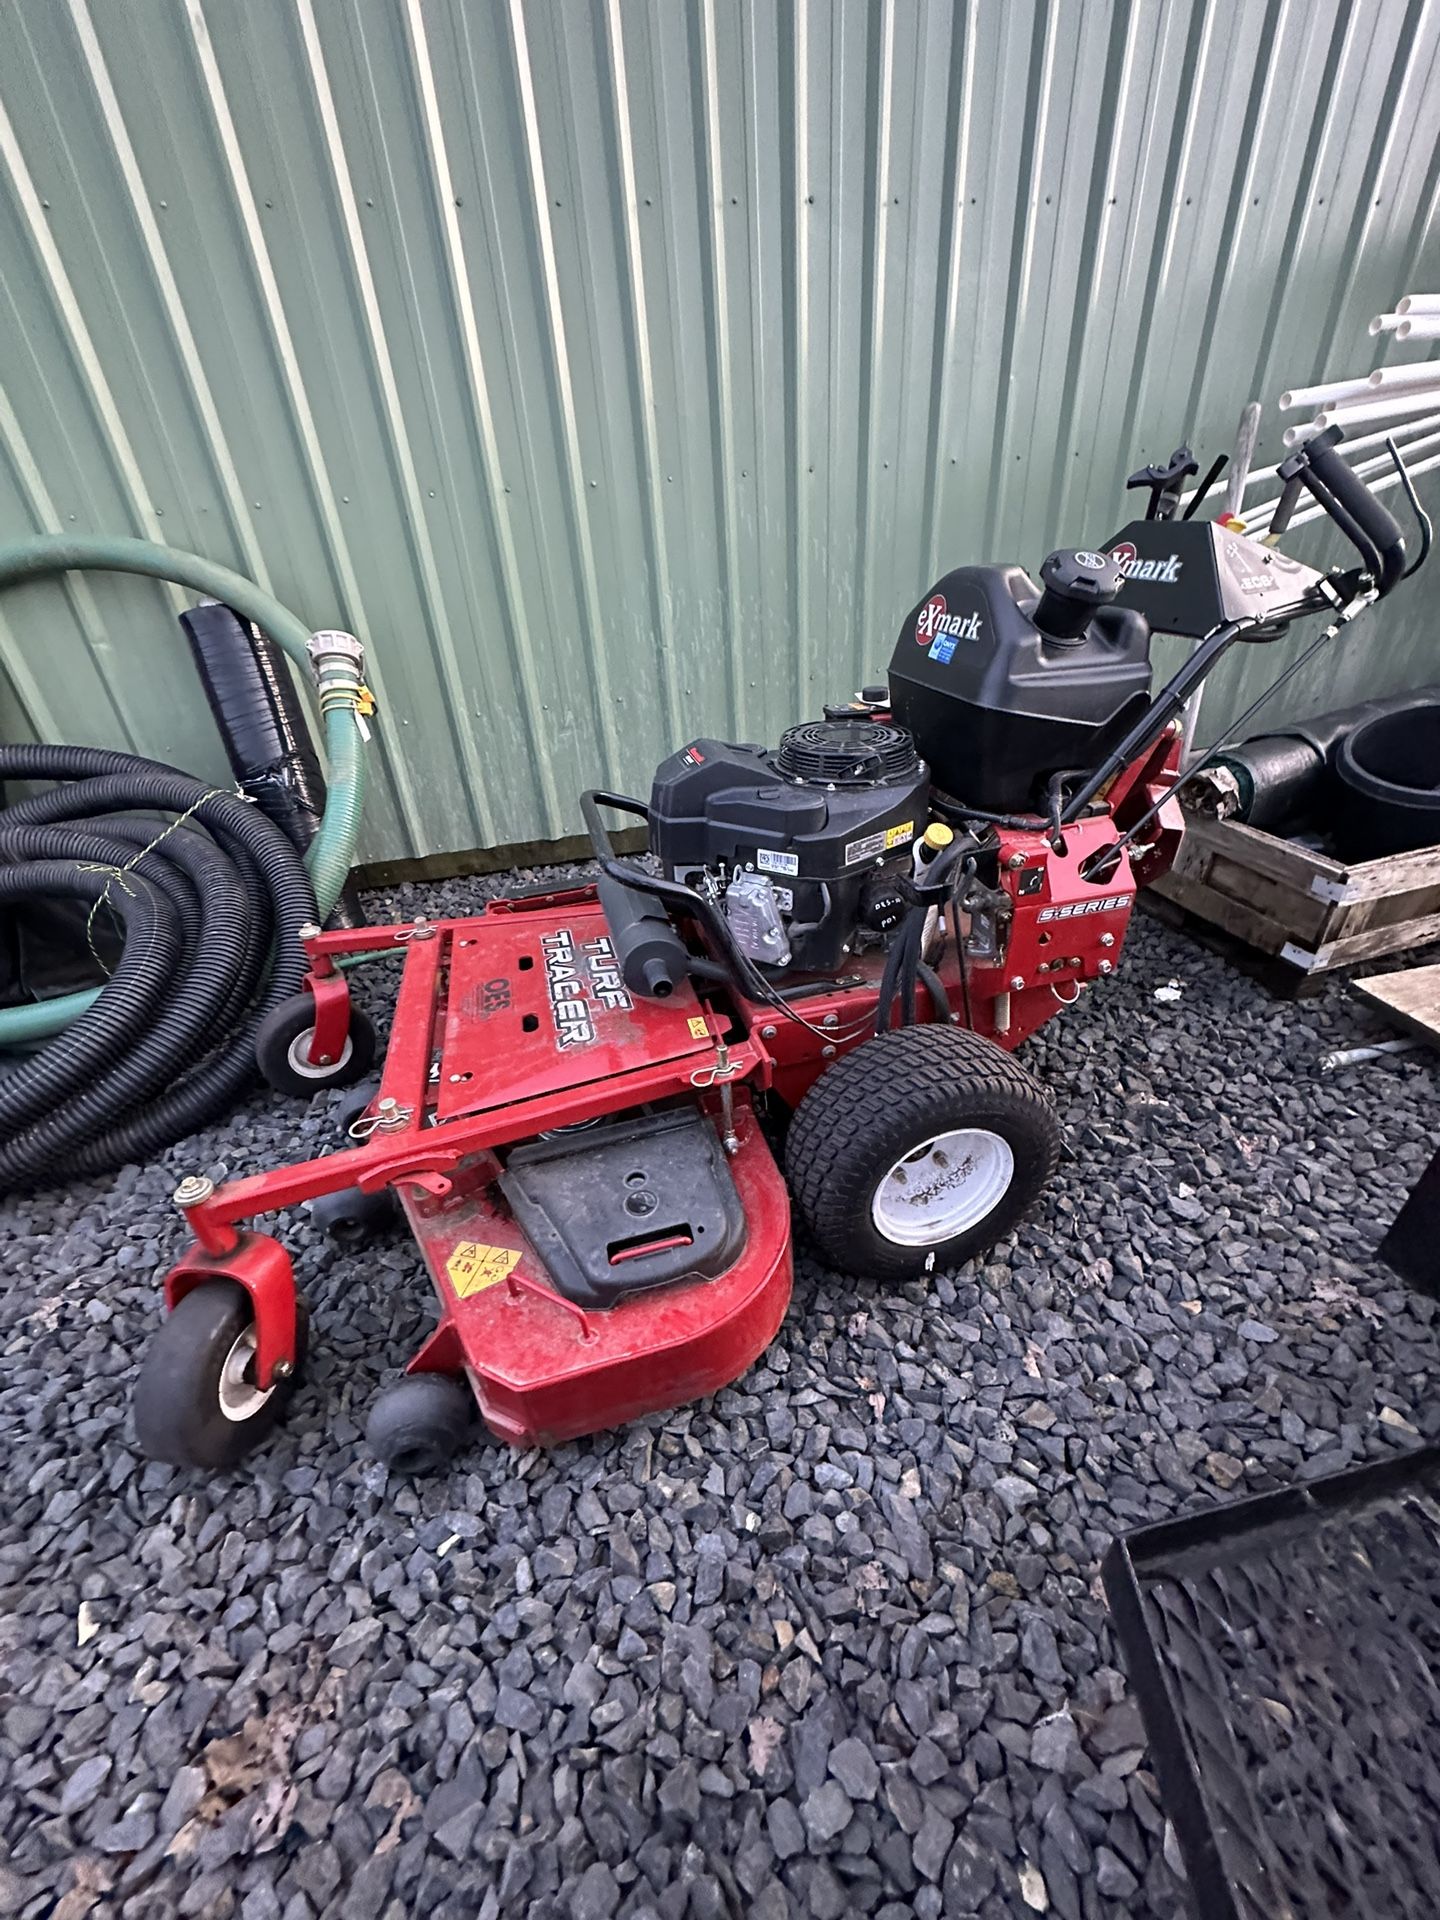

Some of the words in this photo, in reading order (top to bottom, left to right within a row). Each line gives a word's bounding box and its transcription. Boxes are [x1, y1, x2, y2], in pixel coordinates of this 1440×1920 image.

[917, 603, 983, 641] eXmark
[484, 977, 512, 1010] OES
[542, 931, 596, 1050] TRACER
[582, 937, 632, 1010] TURF
